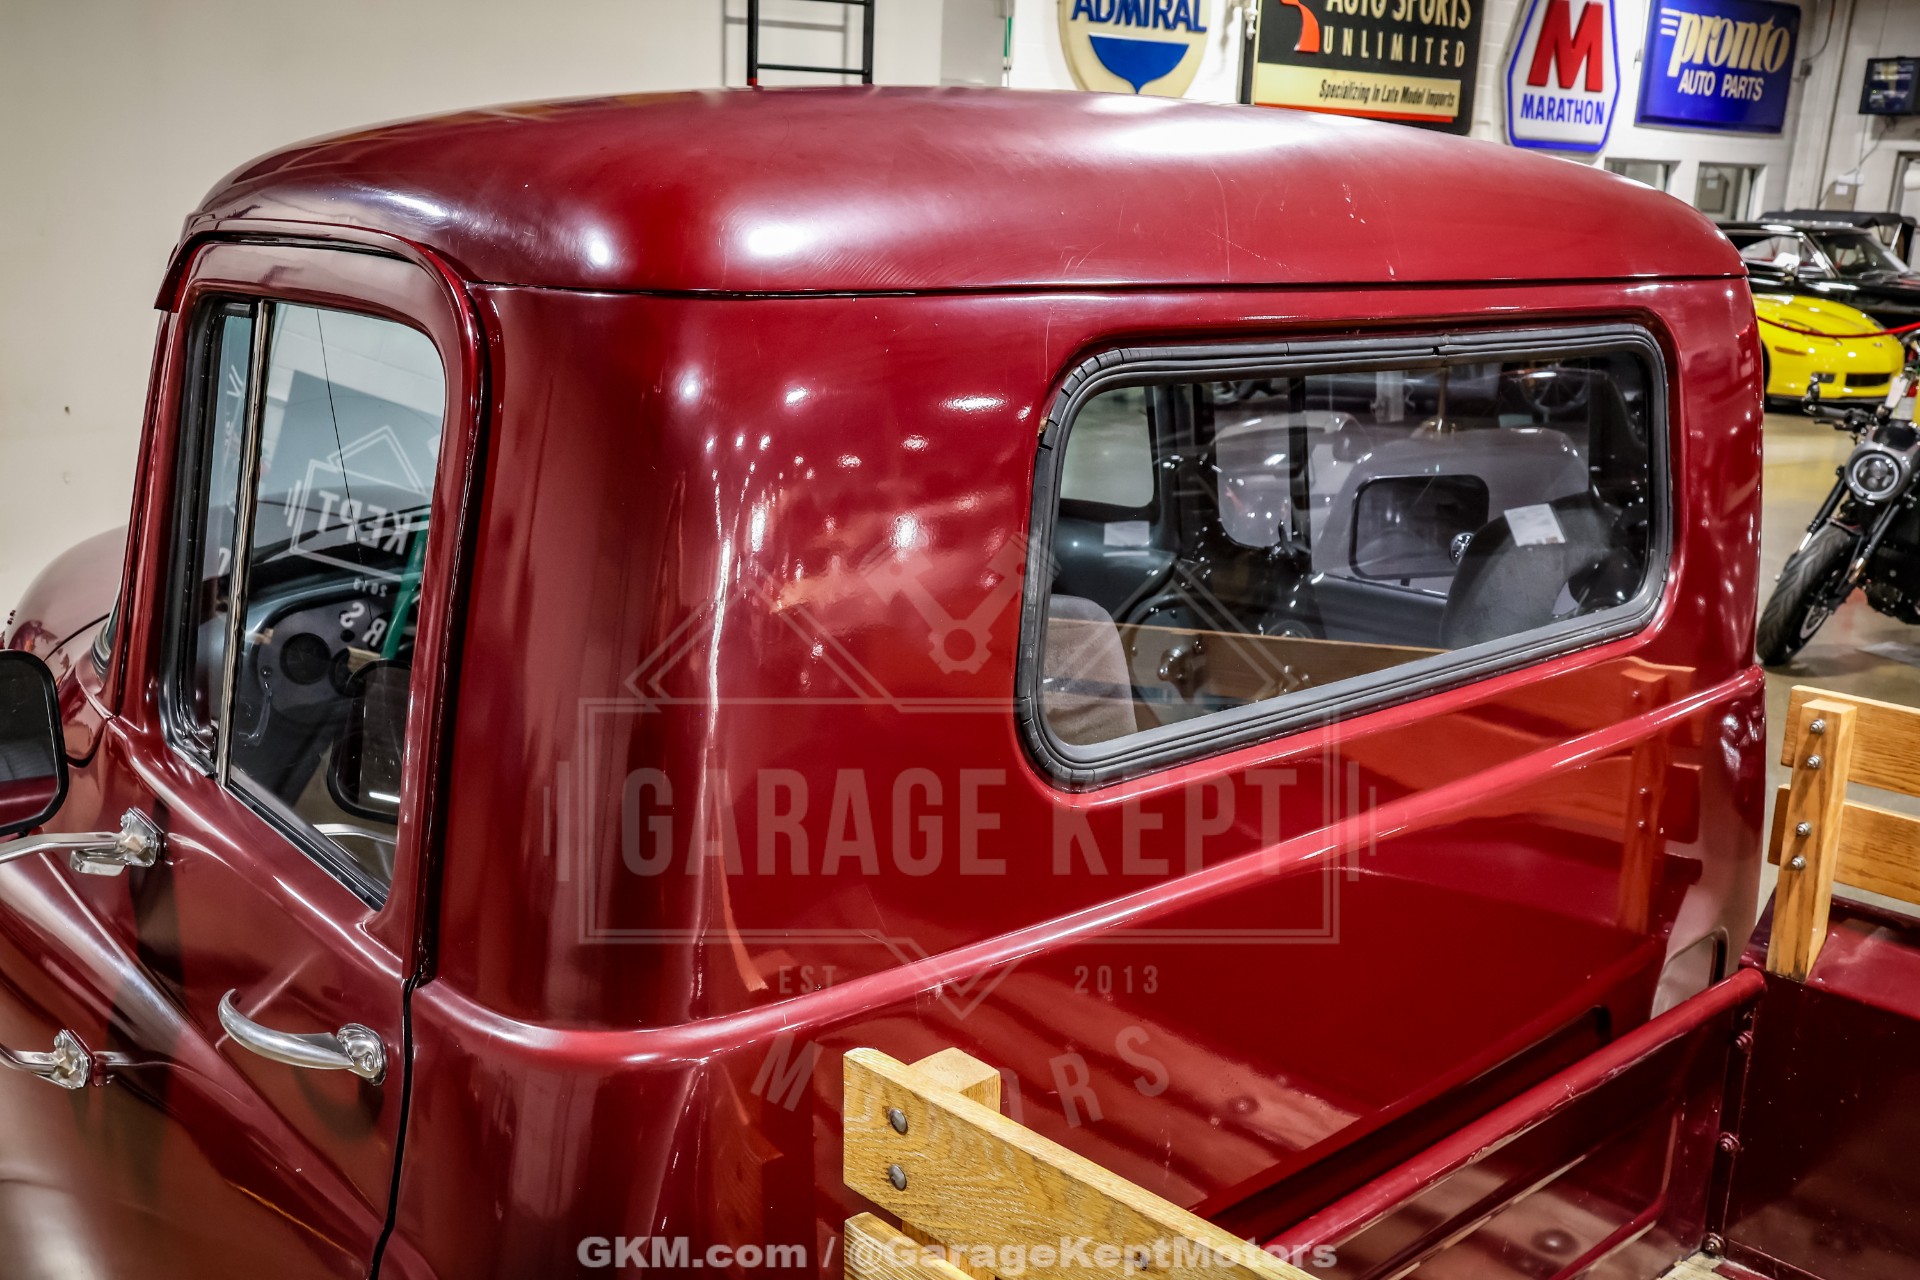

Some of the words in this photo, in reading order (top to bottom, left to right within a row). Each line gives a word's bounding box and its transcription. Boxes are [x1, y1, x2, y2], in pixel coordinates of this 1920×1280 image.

[1071, 0, 1207, 33] ADMIRAL
[1323, 25, 1466, 68] UNLIMITED
[1526, 0, 1604, 93] M
[1667, 11, 1790, 78] pronto
[1319, 79, 1371, 105] Specializing
[1381, 84, 1399, 103] Late
[1400, 86, 1427, 105] Model
[1677, 68, 1717, 97] AUTO
[1720, 73, 1764, 102] PARTS
[1520, 93, 1605, 125] MARATHON
